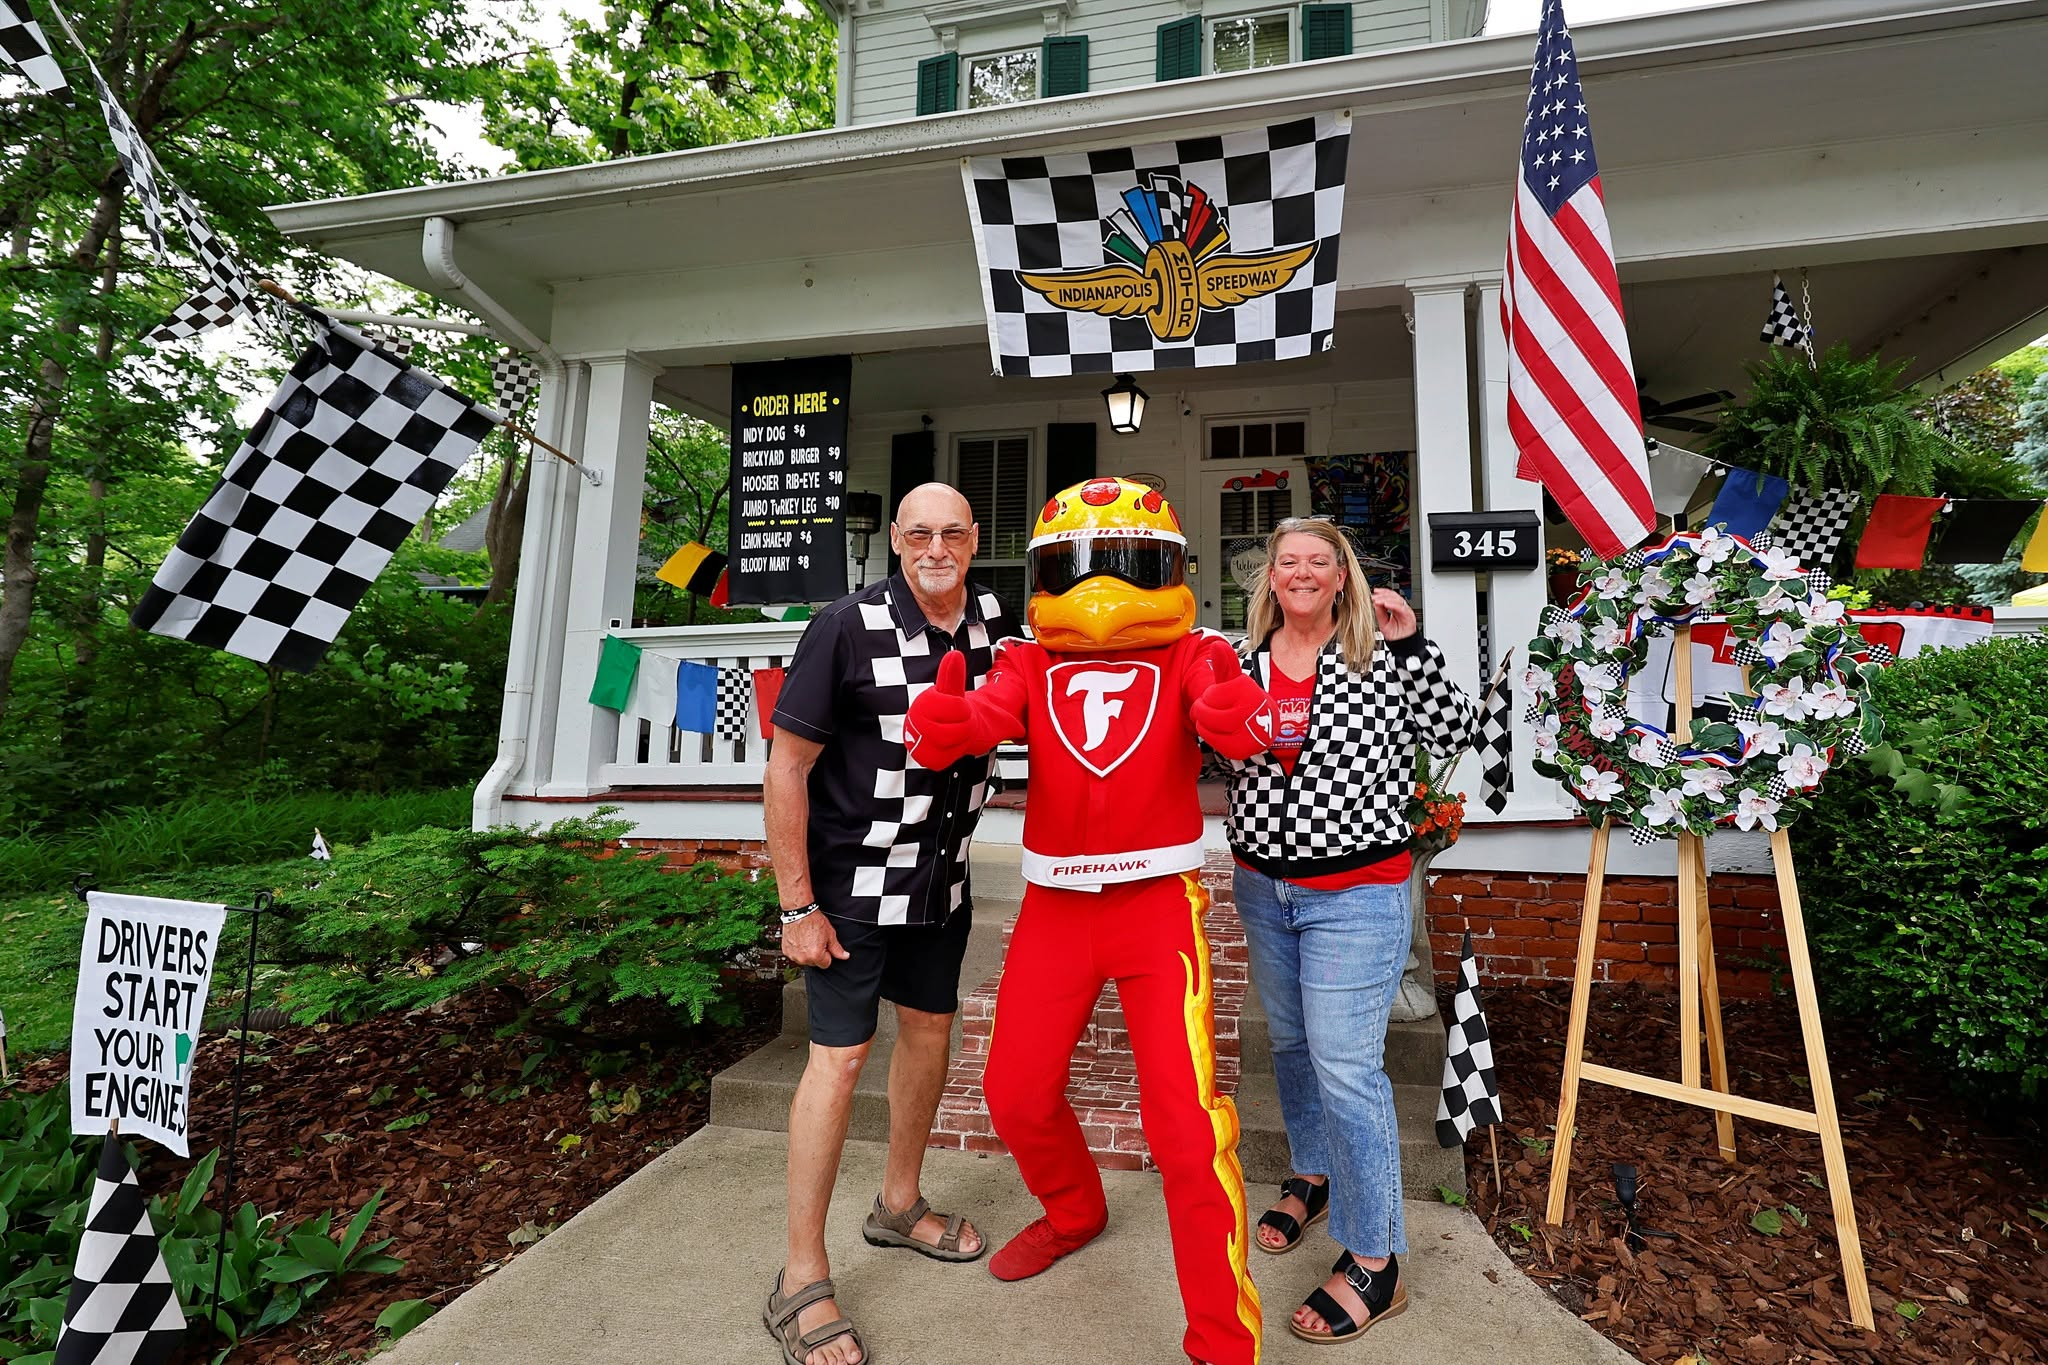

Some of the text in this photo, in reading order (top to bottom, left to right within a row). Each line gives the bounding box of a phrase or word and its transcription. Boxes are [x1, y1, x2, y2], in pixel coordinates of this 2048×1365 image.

[1058, 252, 1278, 328] INDIANAPOLIS MOTOR SPEEDWAY
[753, 391, 828, 417] ORDER HERE
[743, 424, 806, 443] INDY DOG $6
[742, 446, 841, 467] BRICKYARD BURGER $9
[742, 471, 843, 492] HOOSIER RIB-EYE $10
[741, 500, 768, 517] JUMBO
[801, 497, 817, 514] LEG
[825, 496, 840, 510] $10
[740, 531, 812, 549] LEMON SHAKE-UP $6
[1056, 528, 1154, 540] FIREHAWK
[1453, 529, 1517, 558] 345
[740, 555, 810, 573] BLOODY MARY $8
[1556, 663, 1577, 724] Borg
[102, 971, 198, 1031] START
[94, 1027, 164, 1074] YOUR
[85, 1071, 187, 1137] ENGINES
